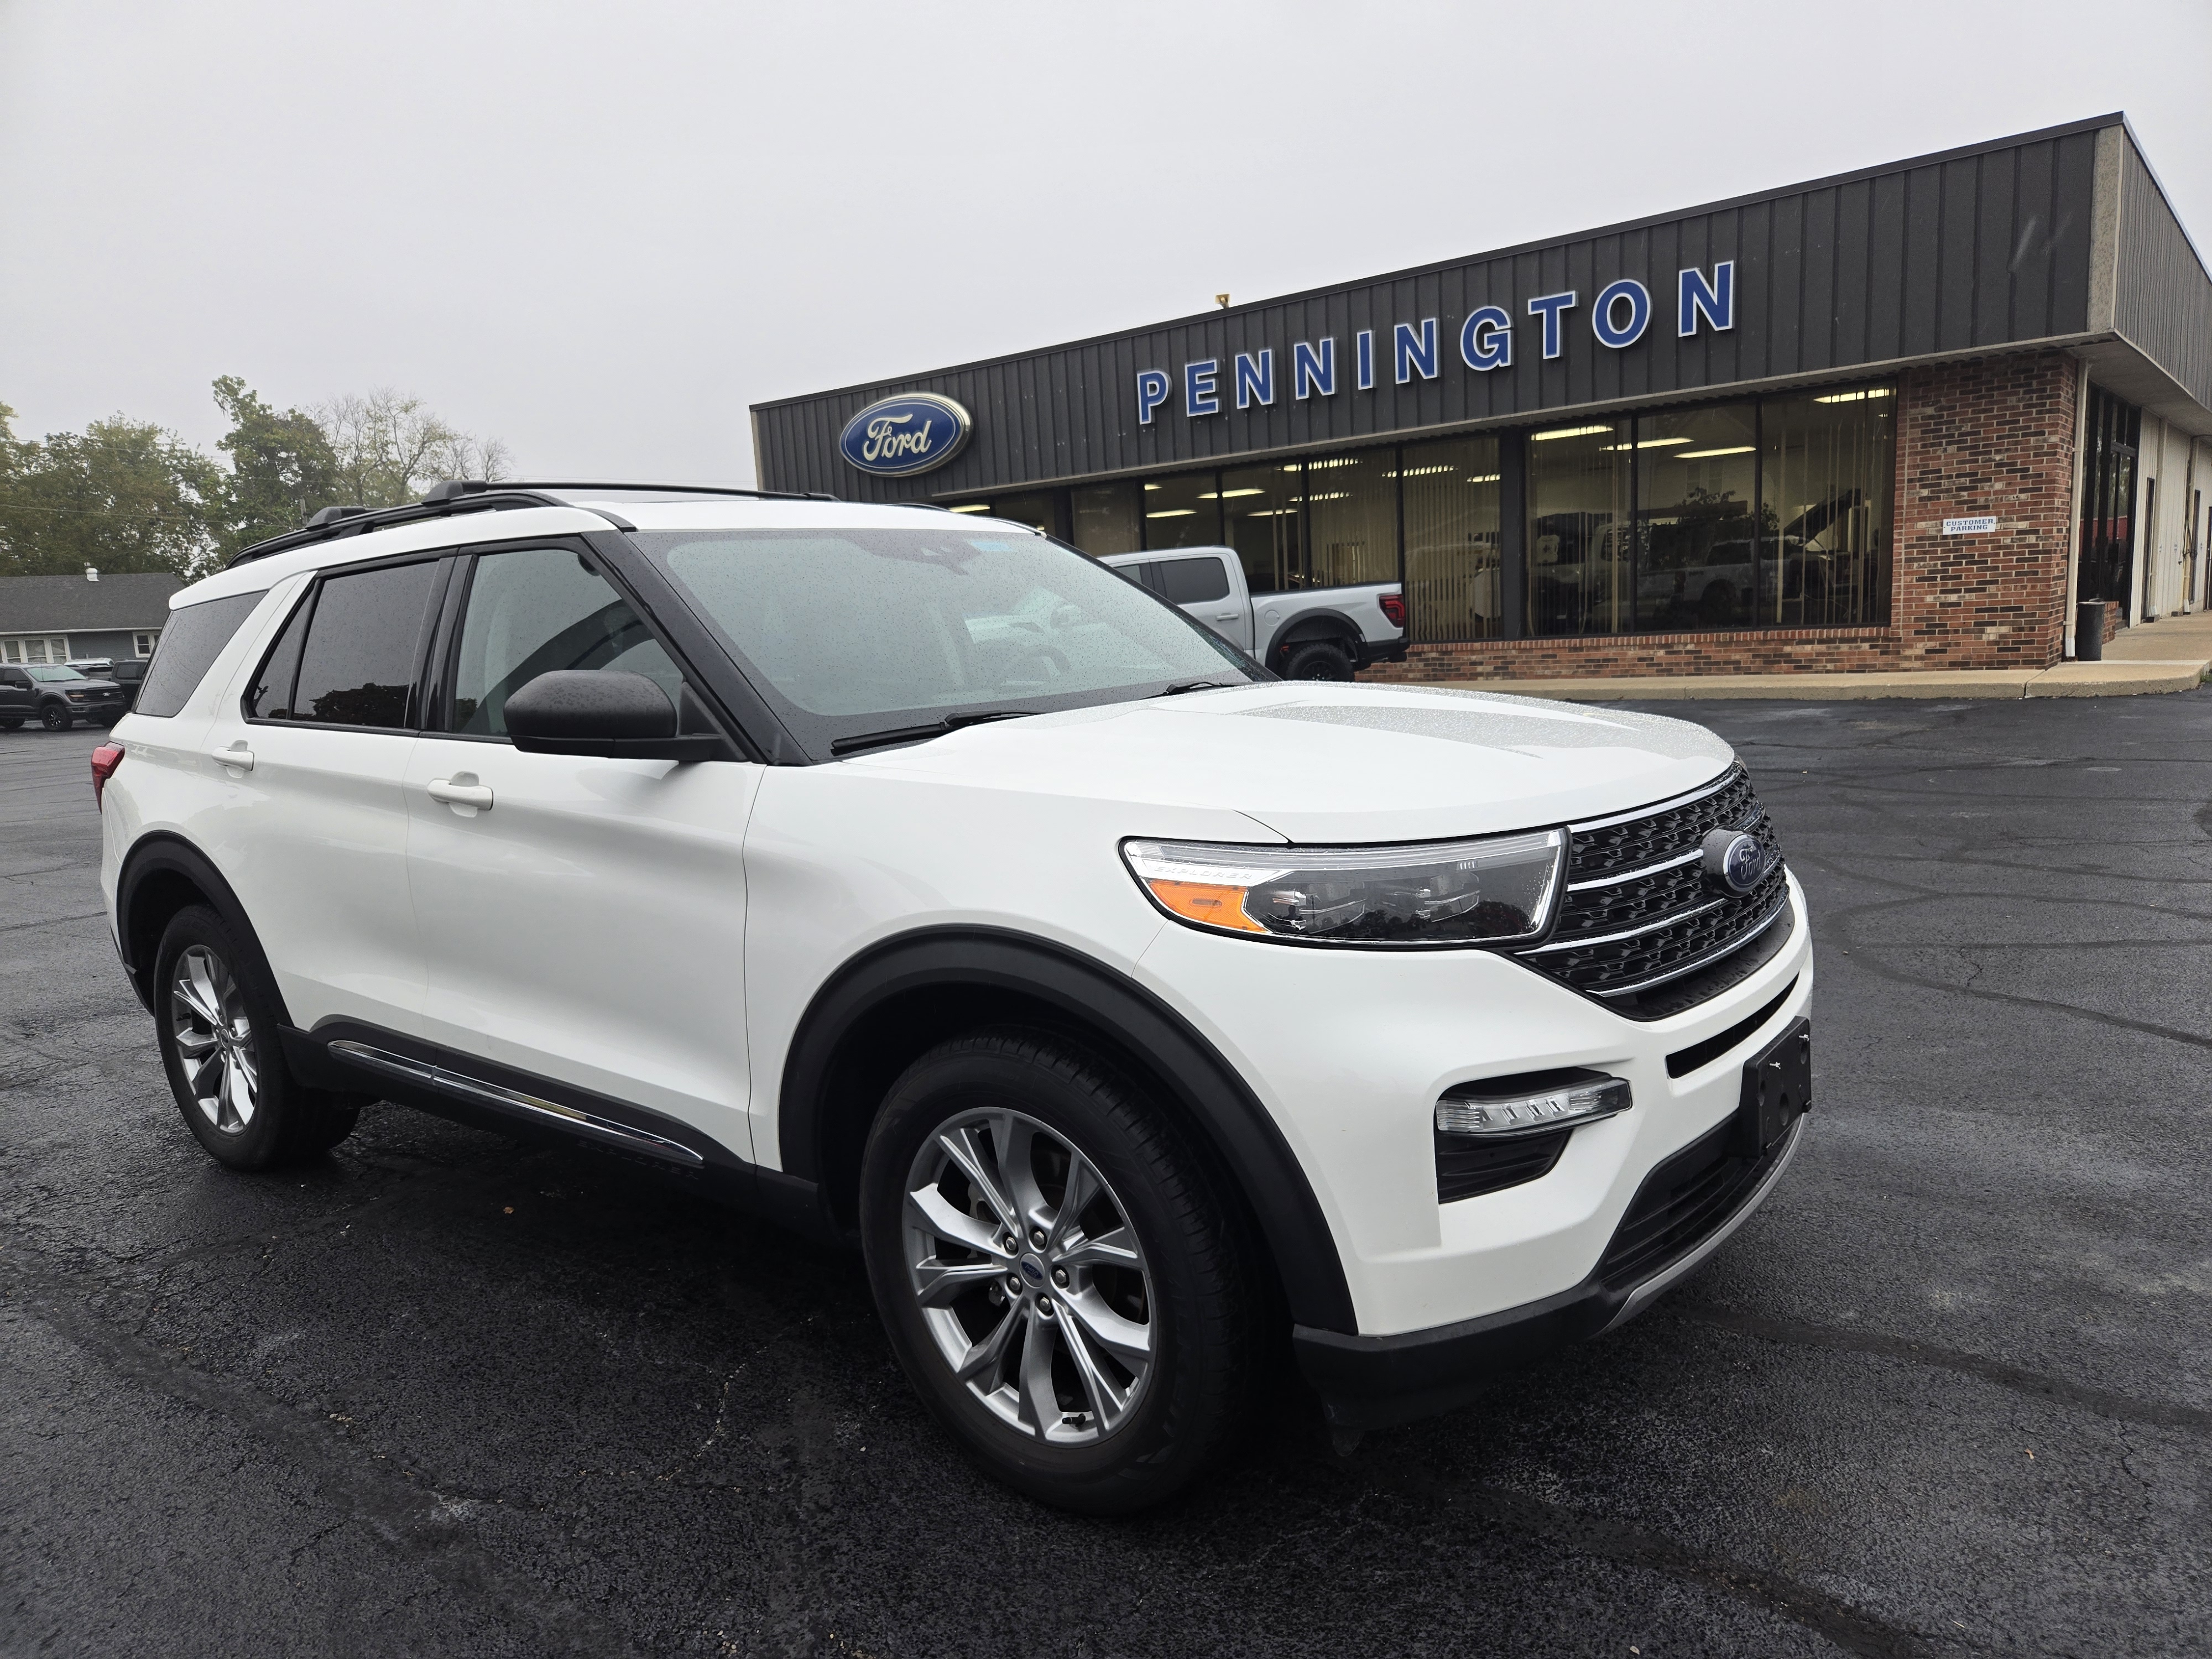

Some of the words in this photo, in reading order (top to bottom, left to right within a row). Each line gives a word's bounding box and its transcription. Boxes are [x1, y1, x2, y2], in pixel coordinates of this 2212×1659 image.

[1137, 260, 1735, 425] PENNINGTON
[863, 414, 932, 461] Ford
[1946, 518, 1994, 526] CUSTOMER
[1154, 866, 1253, 879] EXPLORER
[1739, 846, 1761, 880] Ford
